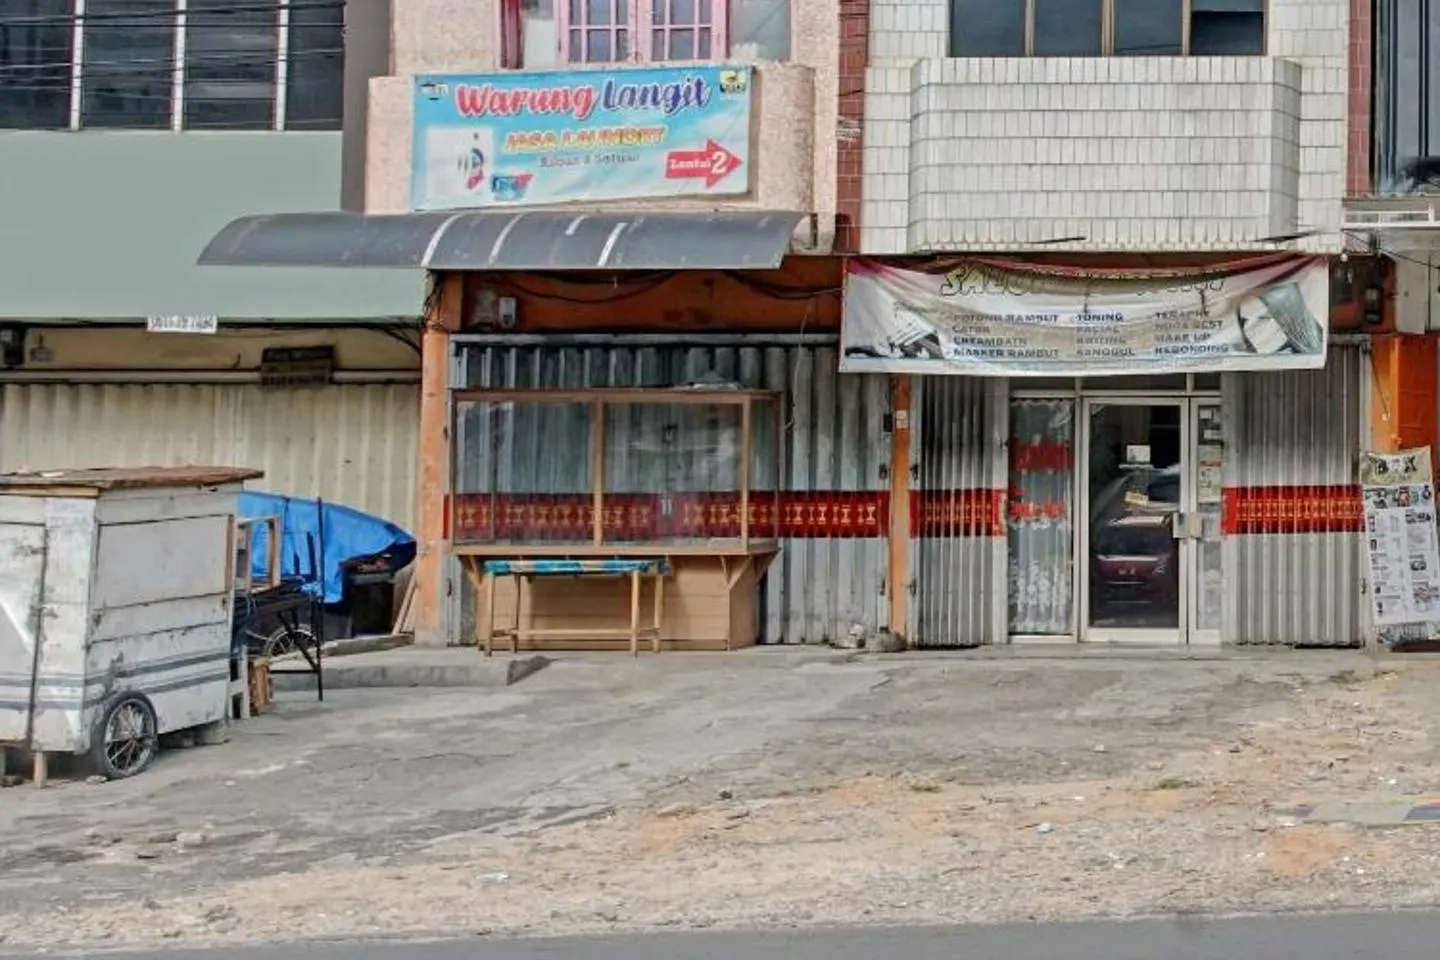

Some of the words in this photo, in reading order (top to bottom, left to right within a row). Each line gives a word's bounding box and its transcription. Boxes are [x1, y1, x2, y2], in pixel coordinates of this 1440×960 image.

[457, 84, 593, 119] Warung
[602, 77, 709, 116] Langit
[711, 151, 728, 174] 2
[1076, 313, 1123, 321] TONING
